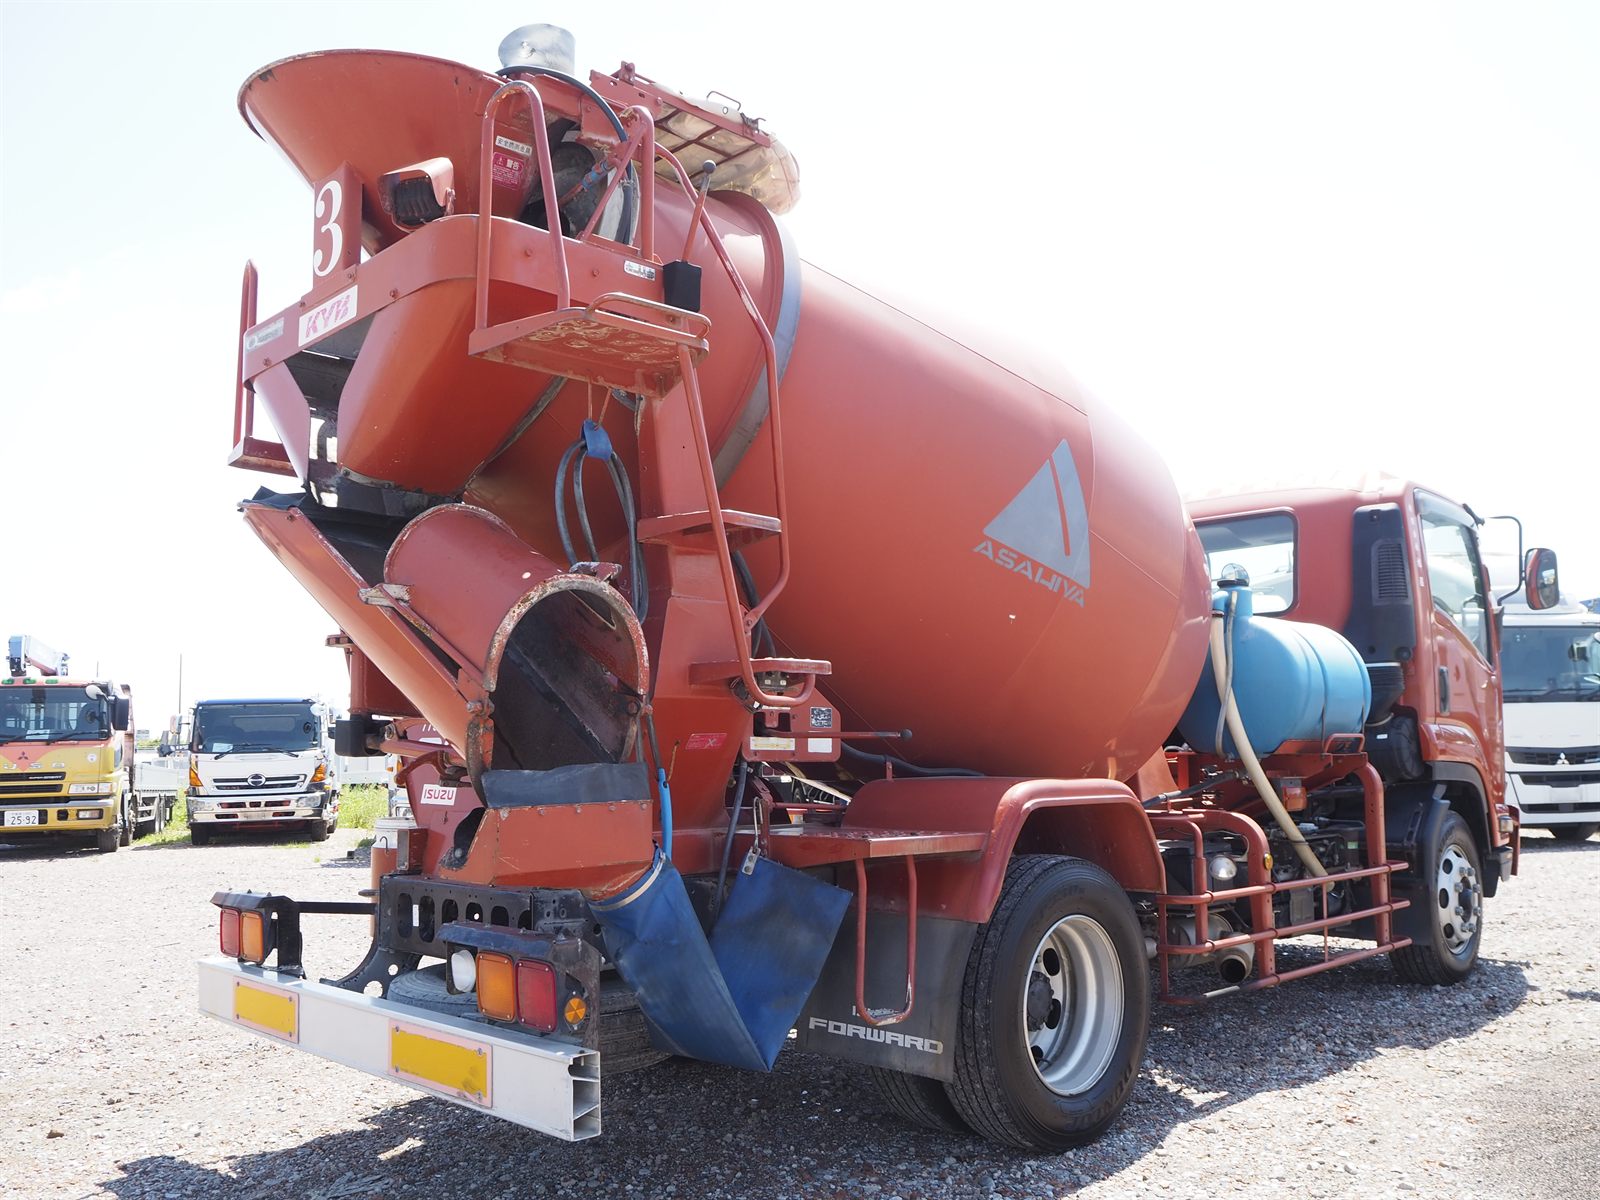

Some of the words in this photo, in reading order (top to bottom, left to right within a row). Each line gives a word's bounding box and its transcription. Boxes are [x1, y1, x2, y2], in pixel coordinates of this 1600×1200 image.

[313, 180, 343, 277] 3
[305, 294, 352, 338] KYB
[973, 540, 1085, 608] ASAHIYA
[423, 789, 455, 800] ISUZU
[808, 1016, 944, 1055] FORWARD
